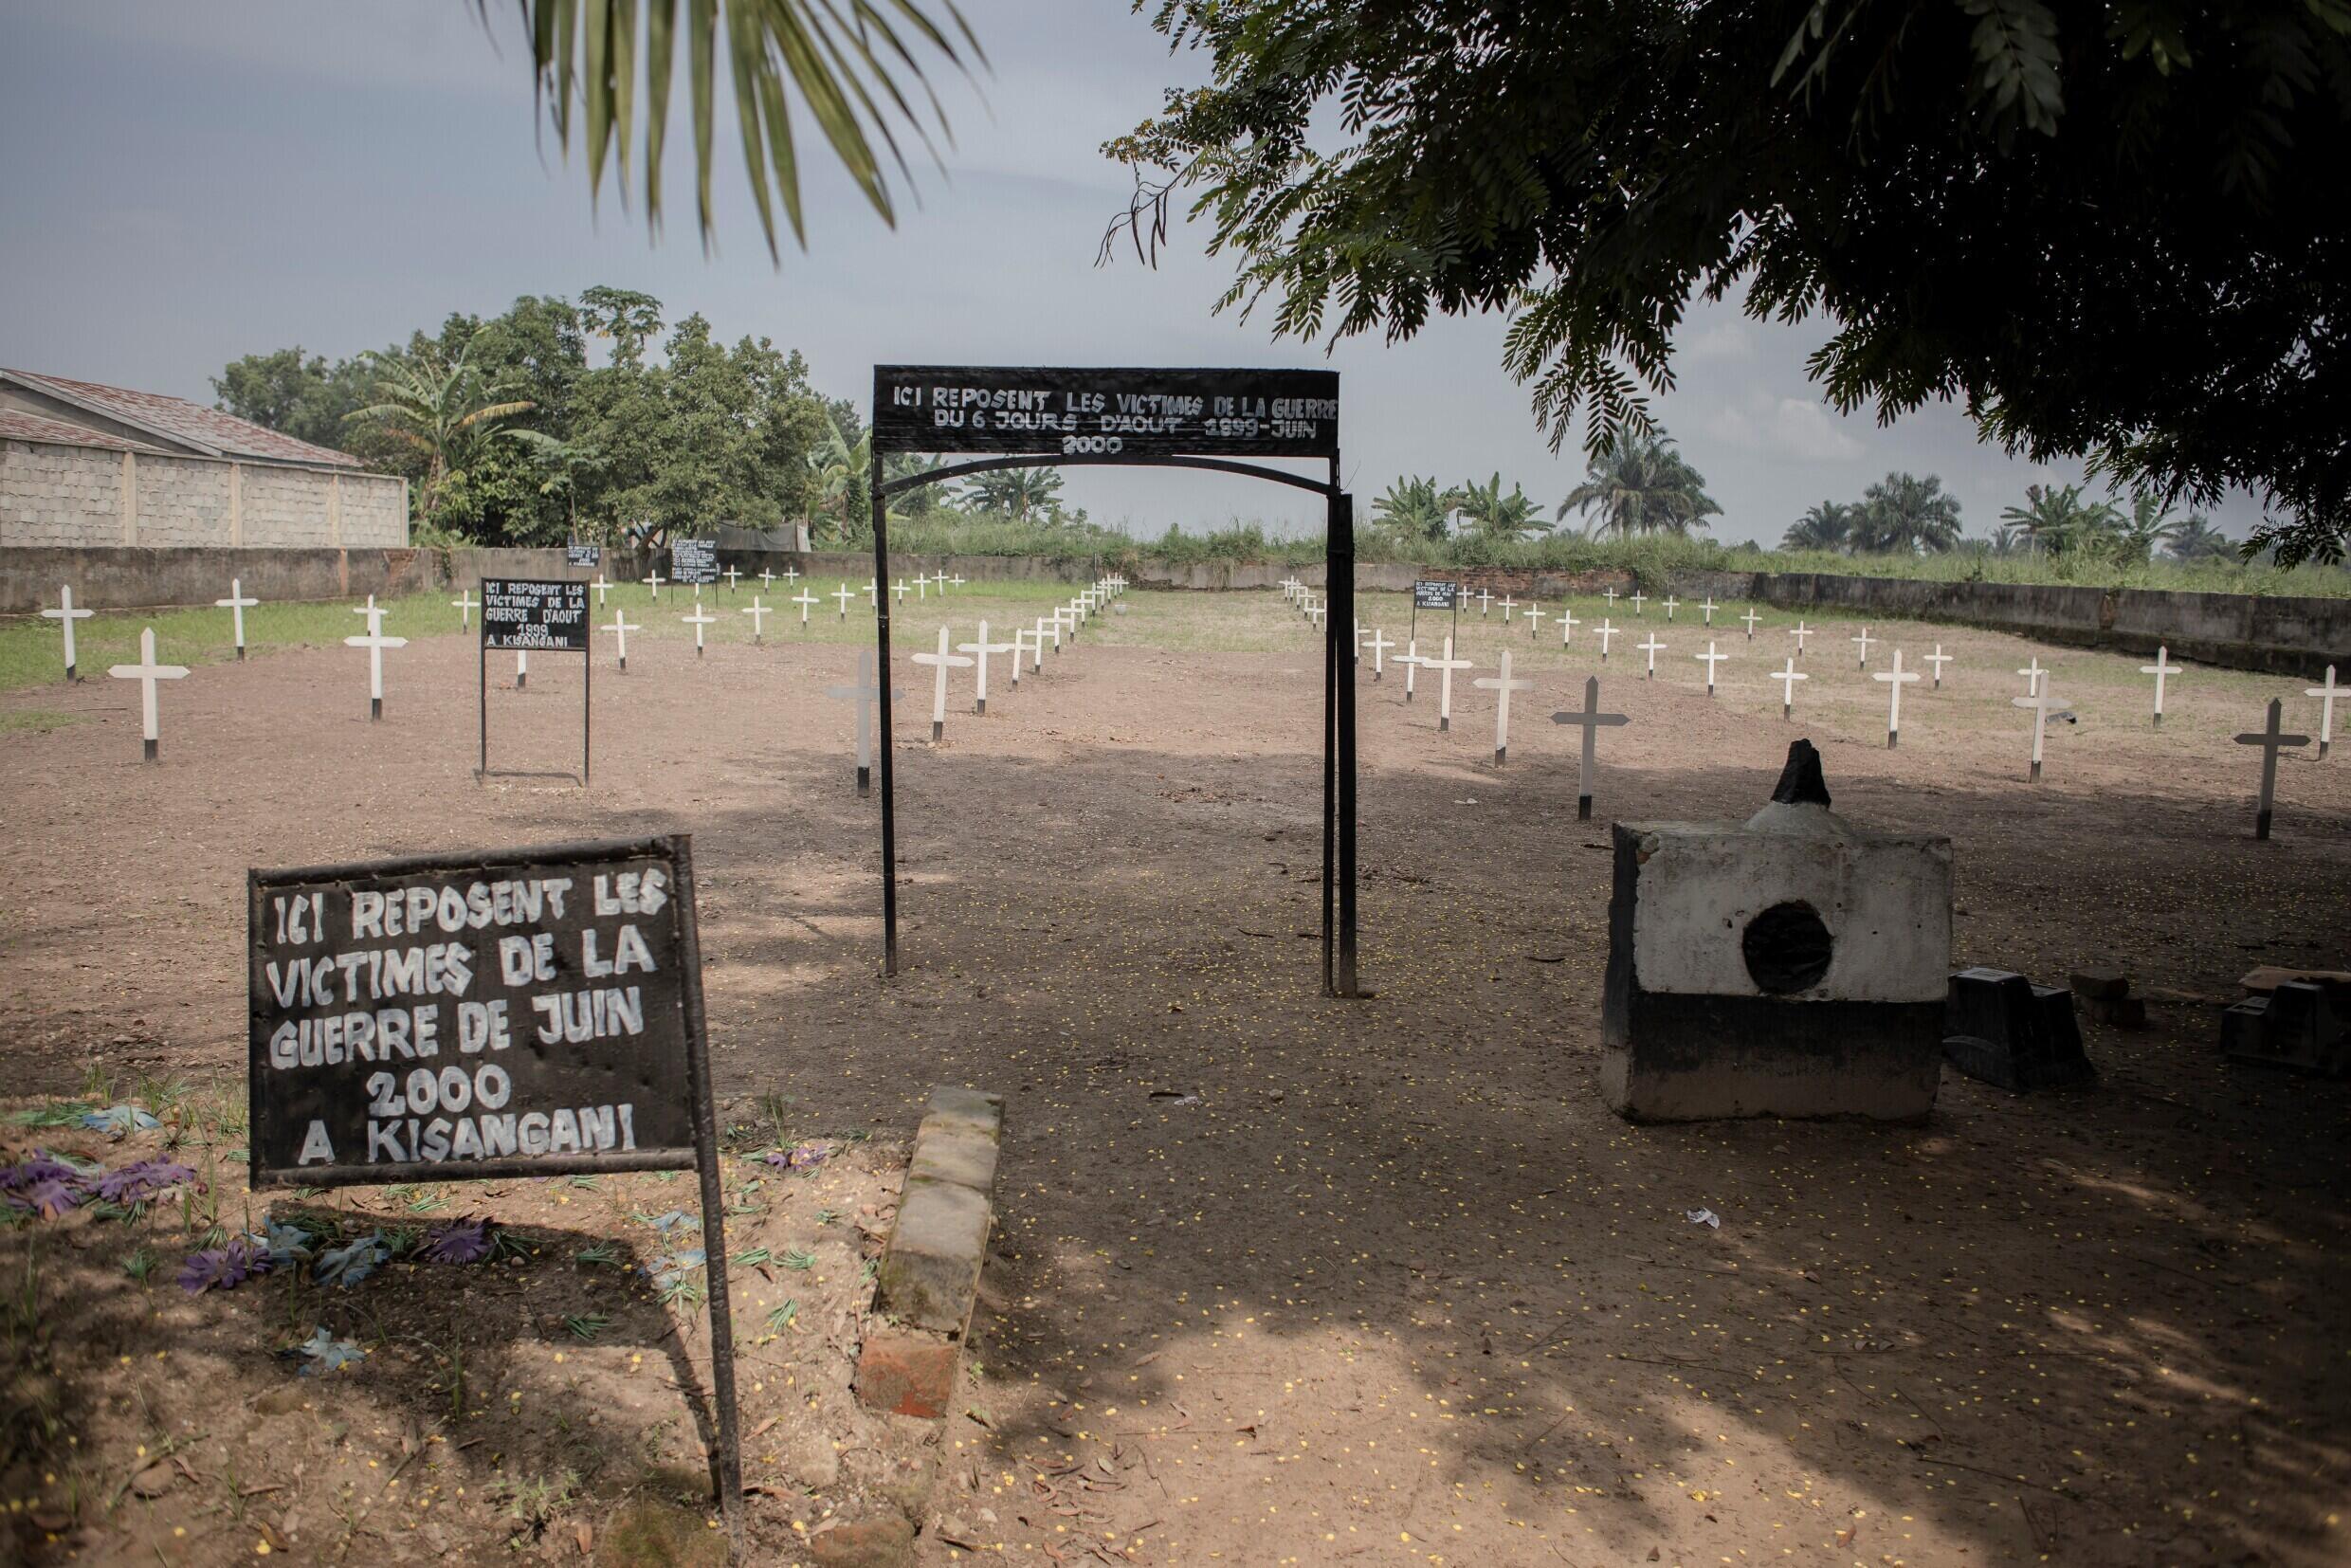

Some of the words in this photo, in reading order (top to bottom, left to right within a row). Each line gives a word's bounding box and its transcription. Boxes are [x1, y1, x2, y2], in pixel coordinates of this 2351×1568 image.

[894, 387, 921, 406] ICI
[933, 387, 1051, 410] REPOSENT
[1066, 392, 1106, 413] LES
[1117, 393, 1204, 415] VICTIMES
[1214, 396, 1234, 416] DE
[1242, 397, 1267, 418] LA
[1271, 398, 1338, 420] GUERRE
[935, 410, 965, 428] DU
[972, 410, 986, 428] 6
[995, 410, 1077, 430] JOURS
[1101, 415, 1183, 433] D'AOUT
[1062, 435, 1123, 454] 2000
[485, 582, 500, 594] ICI
[508, 583, 562, 595] REPOSENT
[565, 584, 584, 595] LES
[485, 594, 539, 607] VICTIMES
[548, 597, 561, 608] DE
[569, 597, 585, 609] LA
[485, 608, 528, 622] GUERRE
[543, 610, 582, 624] D'AOUT
[487, 634, 496, 645] A
[503, 635, 568, 647] KISANGANI
[517, 624, 548, 637] 1999
[275, 892, 324, 944] ICI
[353, 878, 573, 940] REPOSENT
[594, 868, 667, 916] LES
[266, 942, 473, 1009] VICTIMES
[499, 933, 557, 987] DE
[582, 925, 658, 978] LA
[270, 1004, 438, 1070] GUERRE
[458, 999, 510, 1053] DE
[533, 987, 644, 1044] JUIN
[366, 1065, 511, 1117] 2000
[299, 1120, 336, 1165] A
[368, 1103, 635, 1163] KISANGANI
